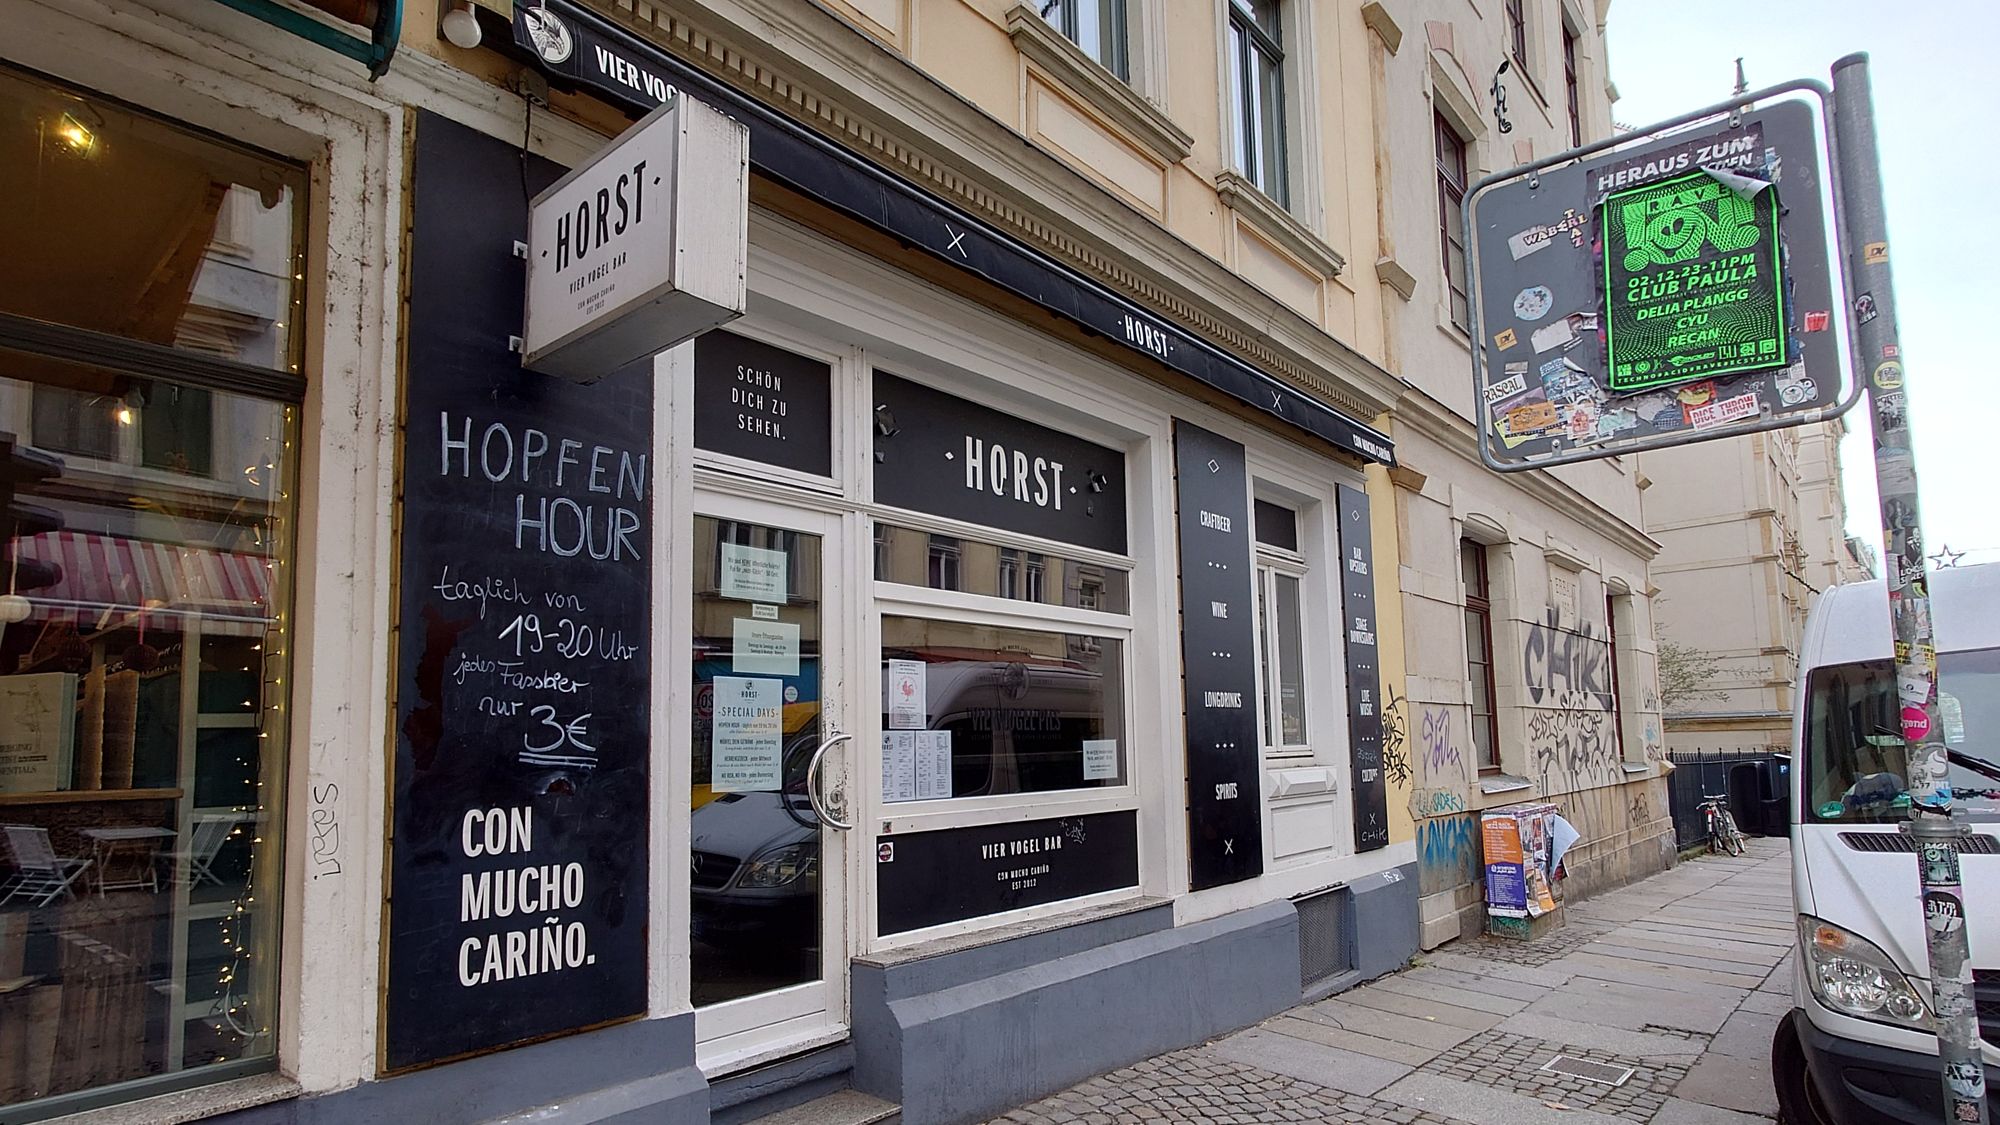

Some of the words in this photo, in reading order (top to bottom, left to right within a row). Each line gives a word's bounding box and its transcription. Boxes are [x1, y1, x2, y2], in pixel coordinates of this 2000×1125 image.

[594, 44, 641, 92] VIER
[1598, 153, 1690, 191] HERAUS
[1696, 136, 1757, 164] ZUM
[555, 159, 647, 274] HORST
[569, 276, 585, 294] VIER
[588, 261, 609, 285] VOGEL
[613, 251, 627, 271] BAR
[1627, 280, 1680, 302] CLUB
[1687, 264, 1758, 290] PAULA
[1636, 302, 1680, 321] DELIA
[1683, 288, 1749, 311] PLANGG
[1677, 313, 1709, 329] CYU
[1125, 314, 1169, 358] HORST
[1668, 327, 1720, 349] RECAN
[737, 365, 781, 392] SCHÖN
[1483, 377, 1523, 403] RASCAL
[732, 387, 763, 411] DICH
[772, 399, 787, 416] ZU
[738, 413, 786, 440] SEHEN.
[1692, 407, 1716, 425] DICE
[440, 411, 646, 502] HOPFEN
[965, 435, 1064, 510] HORST
[515, 494, 641, 561] HOUR
[1200, 509, 1232, 534] CRAFTBEER
[545, 592, 586, 612] von
[1211, 601, 1228, 619] WINE
[498, 613, 594, 659] 19-20
[600, 627, 639, 660] Uhr
[453, 652, 496, 685] jedes
[498, 660, 591, 693] Fassbier
[741, 690, 758, 699] HORST
[1204, 691, 1241, 710] LONGDRINKS
[1360, 702, 1373, 716] MUSIC
[479, 696, 524, 716] nur
[524, 704, 597, 752] 3€
[1780, 765, 1787, 773] P
[1215, 783, 1238, 801] SPIRITS
[462, 806, 532, 858] CON
[982, 843, 1006, 859] VIER
[1010, 838, 1041, 856] VOGEL
[1044, 835, 1063, 850] BAR
[997, 872, 1009, 882] CON
[1010, 869, 1029, 880] MUCHO
[1012, 881, 1022, 891] EST
[1023, 878, 1037, 889] 2012
[461, 862, 584, 922] MUCHO
[458, 916, 596, 987] CARIÑO.
